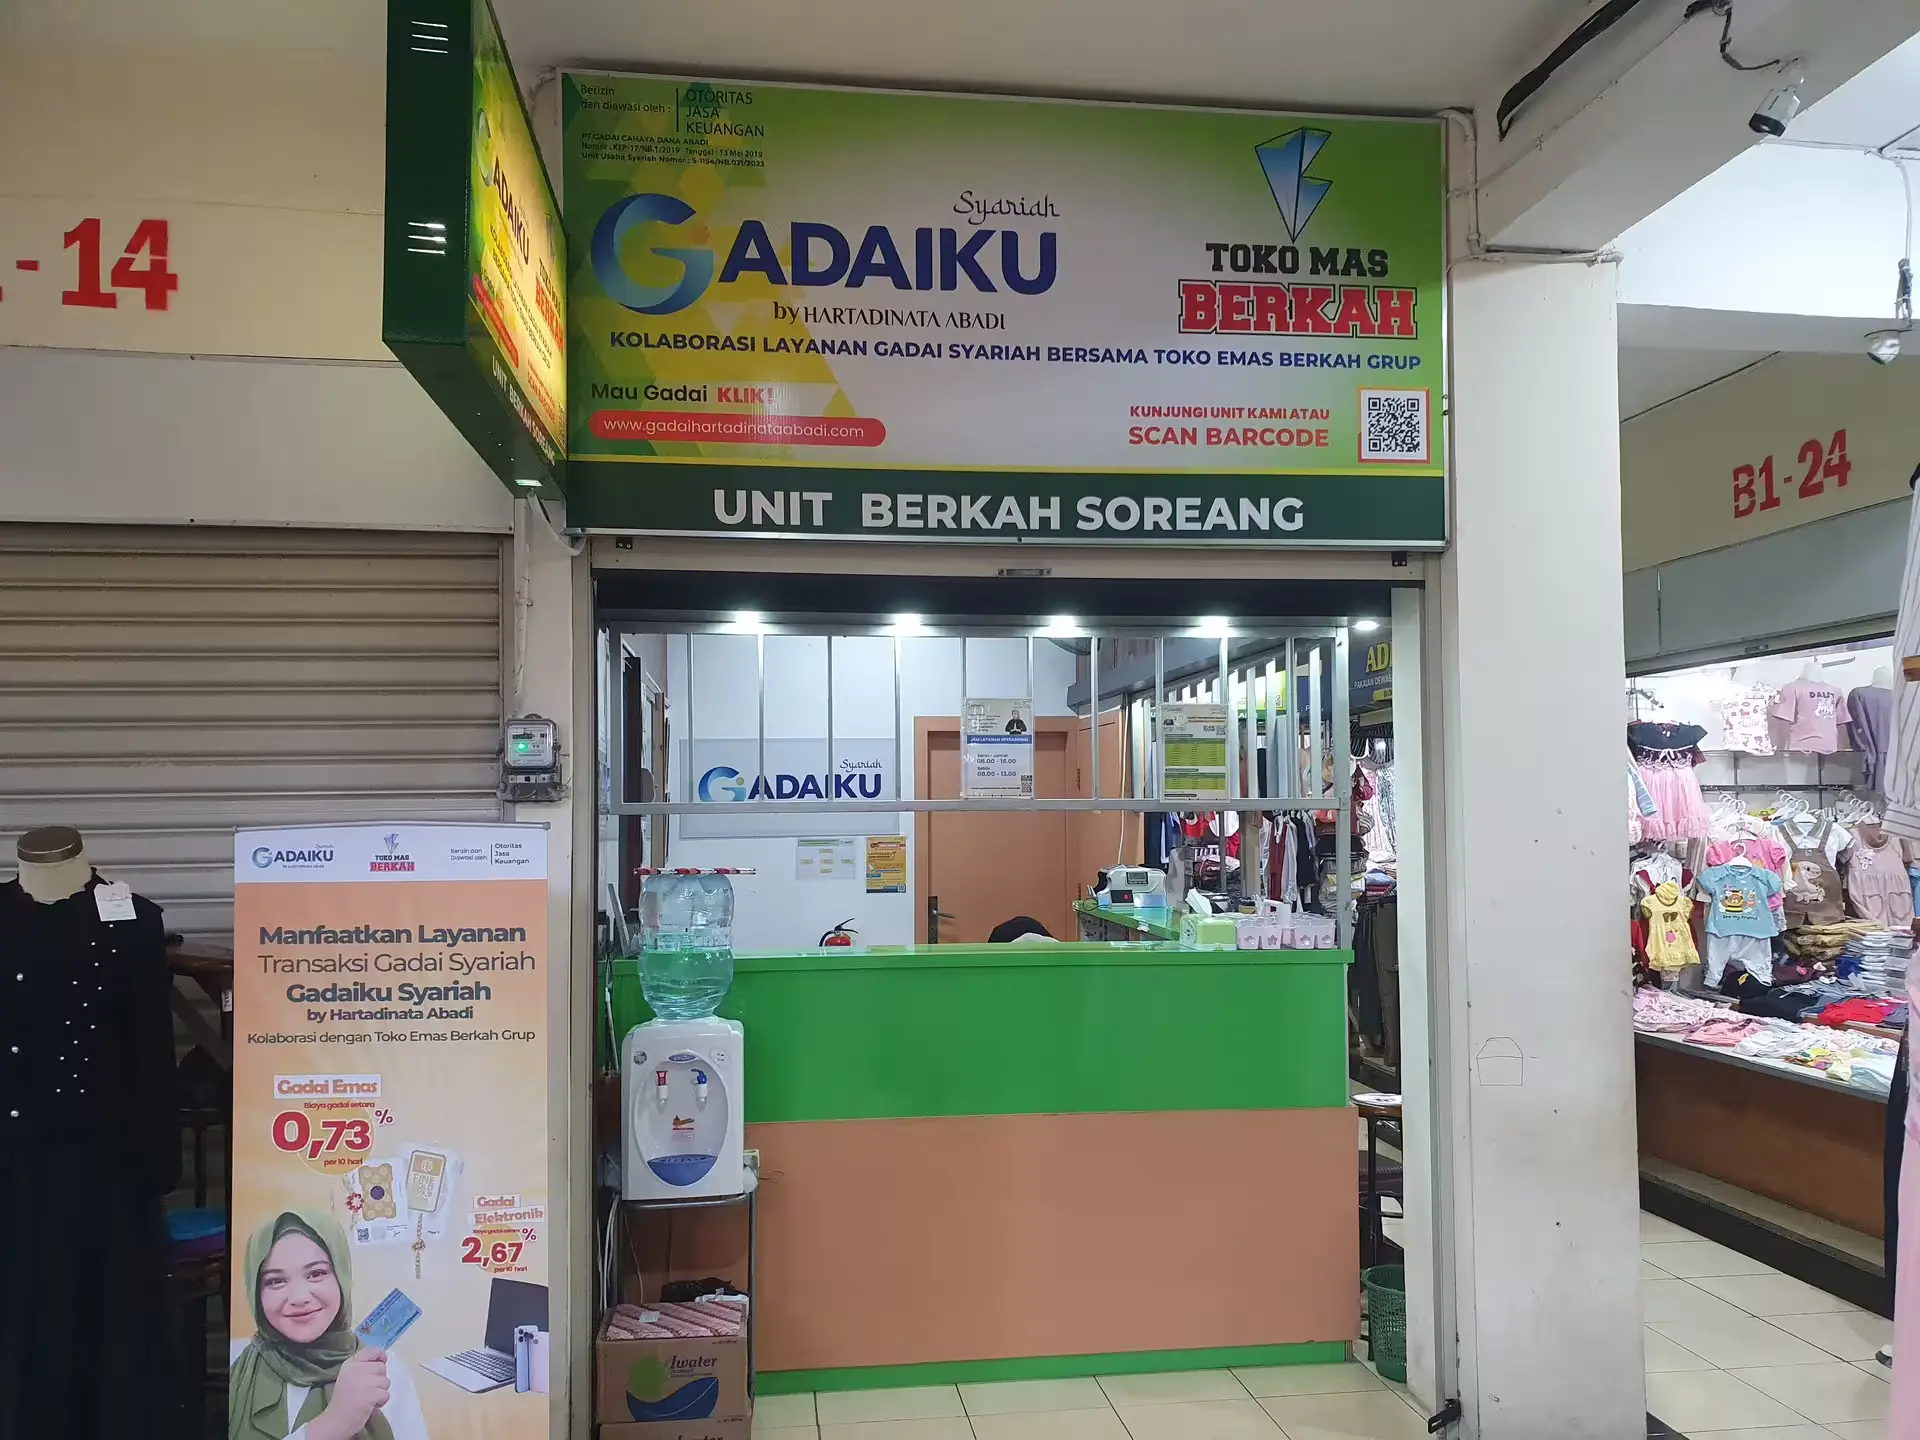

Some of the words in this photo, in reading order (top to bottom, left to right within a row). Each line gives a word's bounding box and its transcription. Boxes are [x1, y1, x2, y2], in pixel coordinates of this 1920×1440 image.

[580, 85, 614, 96] Berizin
[686, 89, 752, 104] OTORITAS
[580, 100, 600, 110] dan
[603, 100, 640, 112] diawasi
[643, 103, 665, 113] oleh
[685, 106, 719, 118] JASA
[686, 121, 764, 137] KEUANGAN
[621, 135, 655, 143] CAHAYA
[657, 136, 681, 144] DANA
[683, 138, 709, 146] ABADI
[953, 190, 1060, 225] Syariah
[591, 193, 1058, 315] GADAIKU
[1206, 242, 1299, 274] TOKO
[1310, 246, 1388, 278] MAS
[773, 301, 799, 323] by
[804, 305, 940, 327] HARTADINATA
[946, 310, 1006, 330] ABADI
[1178, 280, 1418, 339] BERKAH
[610, 332, 755, 352] KOLABORASI
[763, 335, 867, 356] LAYANAN
[874, 340, 942, 359] GADAI
[949, 343, 1040, 362] SYARIAH
[1047, 347, 1148, 365] BERSAMA
[1153, 350, 1211, 366] TOKO
[1217, 351, 1273, 367] EMAS
[1279, 352, 1361, 369] BERKAH
[1367, 353, 1421, 370] GRUP
[591, 382, 637, 401] Mau
[644, 384, 707, 403] Gadai
[1130, 405, 1208, 419] KUNJUNGI
[1210, 406, 1244, 419] UNIT
[1247, 407, 1287, 420] KAMI
[1289, 407, 1330, 420] ATAU
[604, 418, 865, 439] www.gadaihartadinataabadi.com
[1129, 426, 1198, 446] SCAN
[1206, 428, 1329, 447] BARCODE
[1733, 428, 1852, 519] B1-24
[713, 489, 833, 526] UNIT
[861, 493, 1061, 530] BERKAH
[1076, 495, 1304, 531] SOREANG
[839, 758, 882, 773] Syariah
[252, 847, 334, 868] GADAIKU
[369, 861, 415, 872] BERKAH
[259, 925, 412, 945] Manfaatkan
[418, 924, 526, 947] Layanan
[258, 953, 368, 973] Transaksi
[374, 952, 443, 972] Gadai
[448, 951, 536, 975] Syariah
[286, 981, 392, 1003] Gadaiku
[398, 980, 491, 1005] Syariah
[307, 1008, 327, 1023] by
[330, 1007, 423, 1020] Hartadinata
[427, 1006, 474, 1019] Abadi
[248, 1032, 317, 1044] Kolaborasi
[319, 1032, 372, 1047] dengan
[374, 1031, 408, 1043] Toko
[410, 1031, 448, 1042] Emas
[450, 1030, 498, 1041] Berkah
[501, 1029, 536, 1044] Grup
[277, 1079, 329, 1094] Gadai
[477, 1196, 515, 1207] Gadai
[474, 1208, 543, 1224] Elektronik
